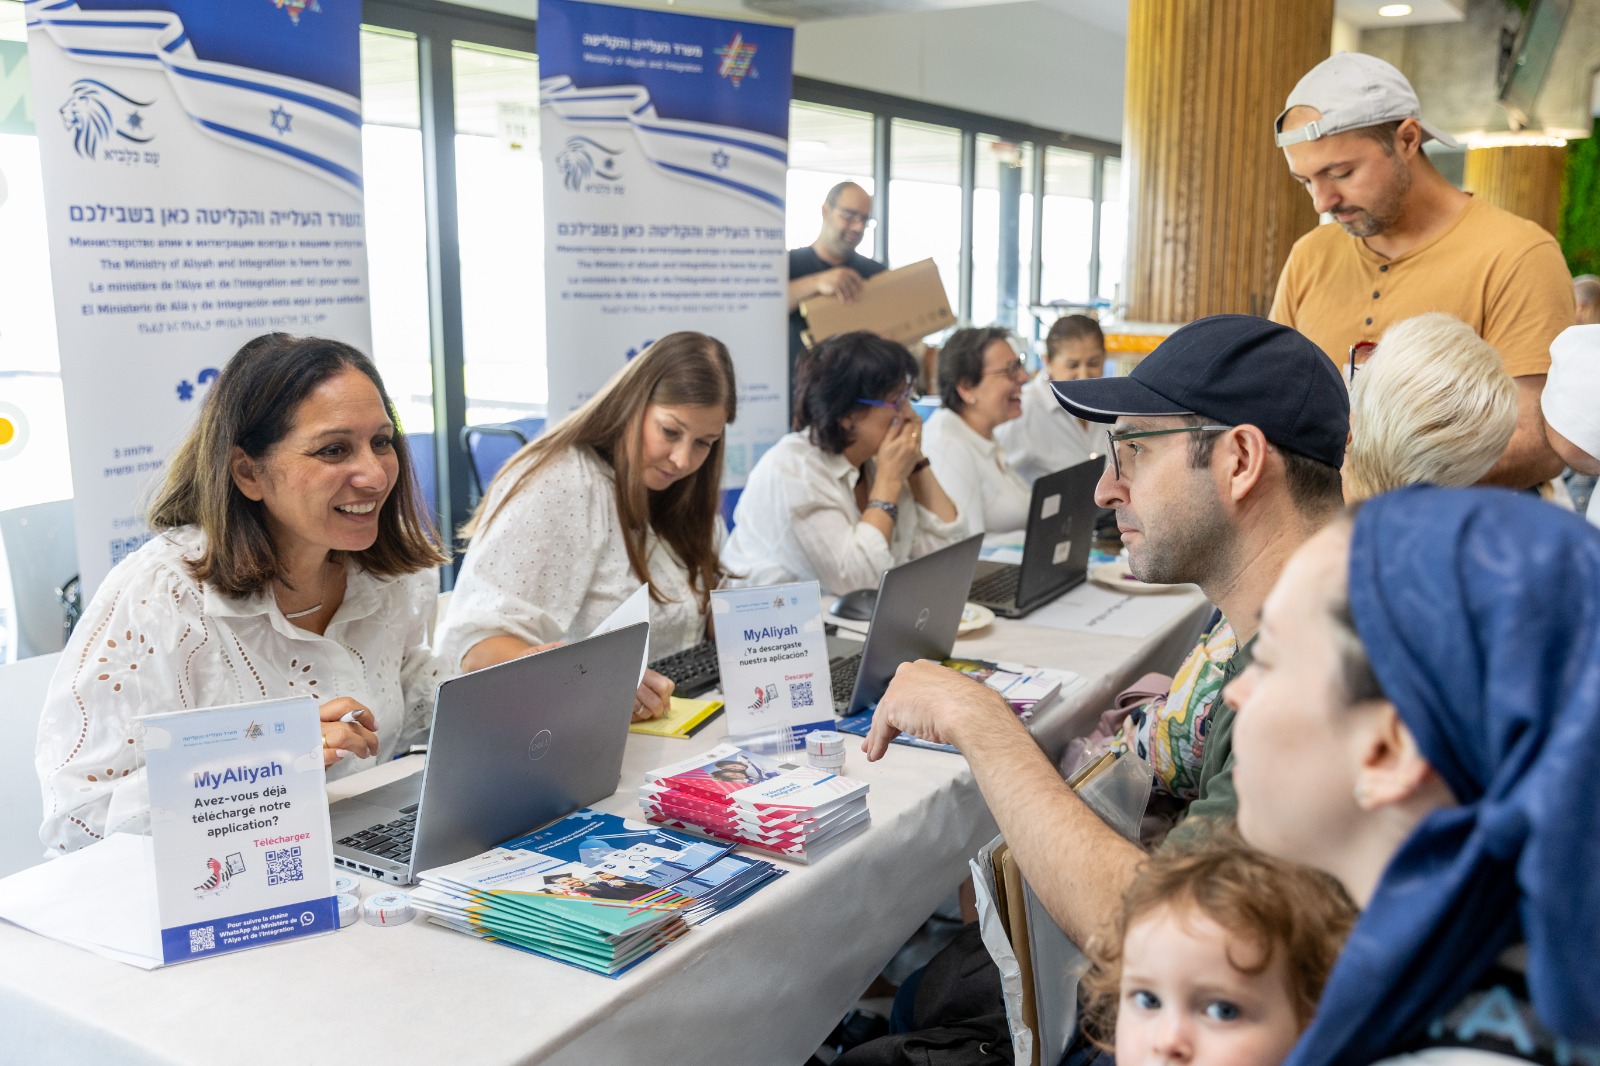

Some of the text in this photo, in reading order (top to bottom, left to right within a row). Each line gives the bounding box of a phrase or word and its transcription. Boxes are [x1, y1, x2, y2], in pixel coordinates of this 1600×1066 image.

[69, 203, 155, 223] בשבילכם
[161, 207, 189, 227] כאן
[196, 207, 265, 228] והקליטה
[269, 209, 322, 227] העלייה
[744, 624, 798, 642] MyAliyah
[759, 641, 802, 653] descargaste
[739, 650, 808, 666] nuestra aplicación?
[784, 672, 814, 681] Descargar
[193, 761, 283, 789] MyAliyah
[194, 785, 287, 808] Avez-vous déjà
[192, 801, 291, 824] téléchargé notre
[207, 816, 279, 838] application?
[253, 832, 311, 848] Téléchargez
[243, 917, 262, 926] suivre
[219, 927, 251, 938] WhatsApp
